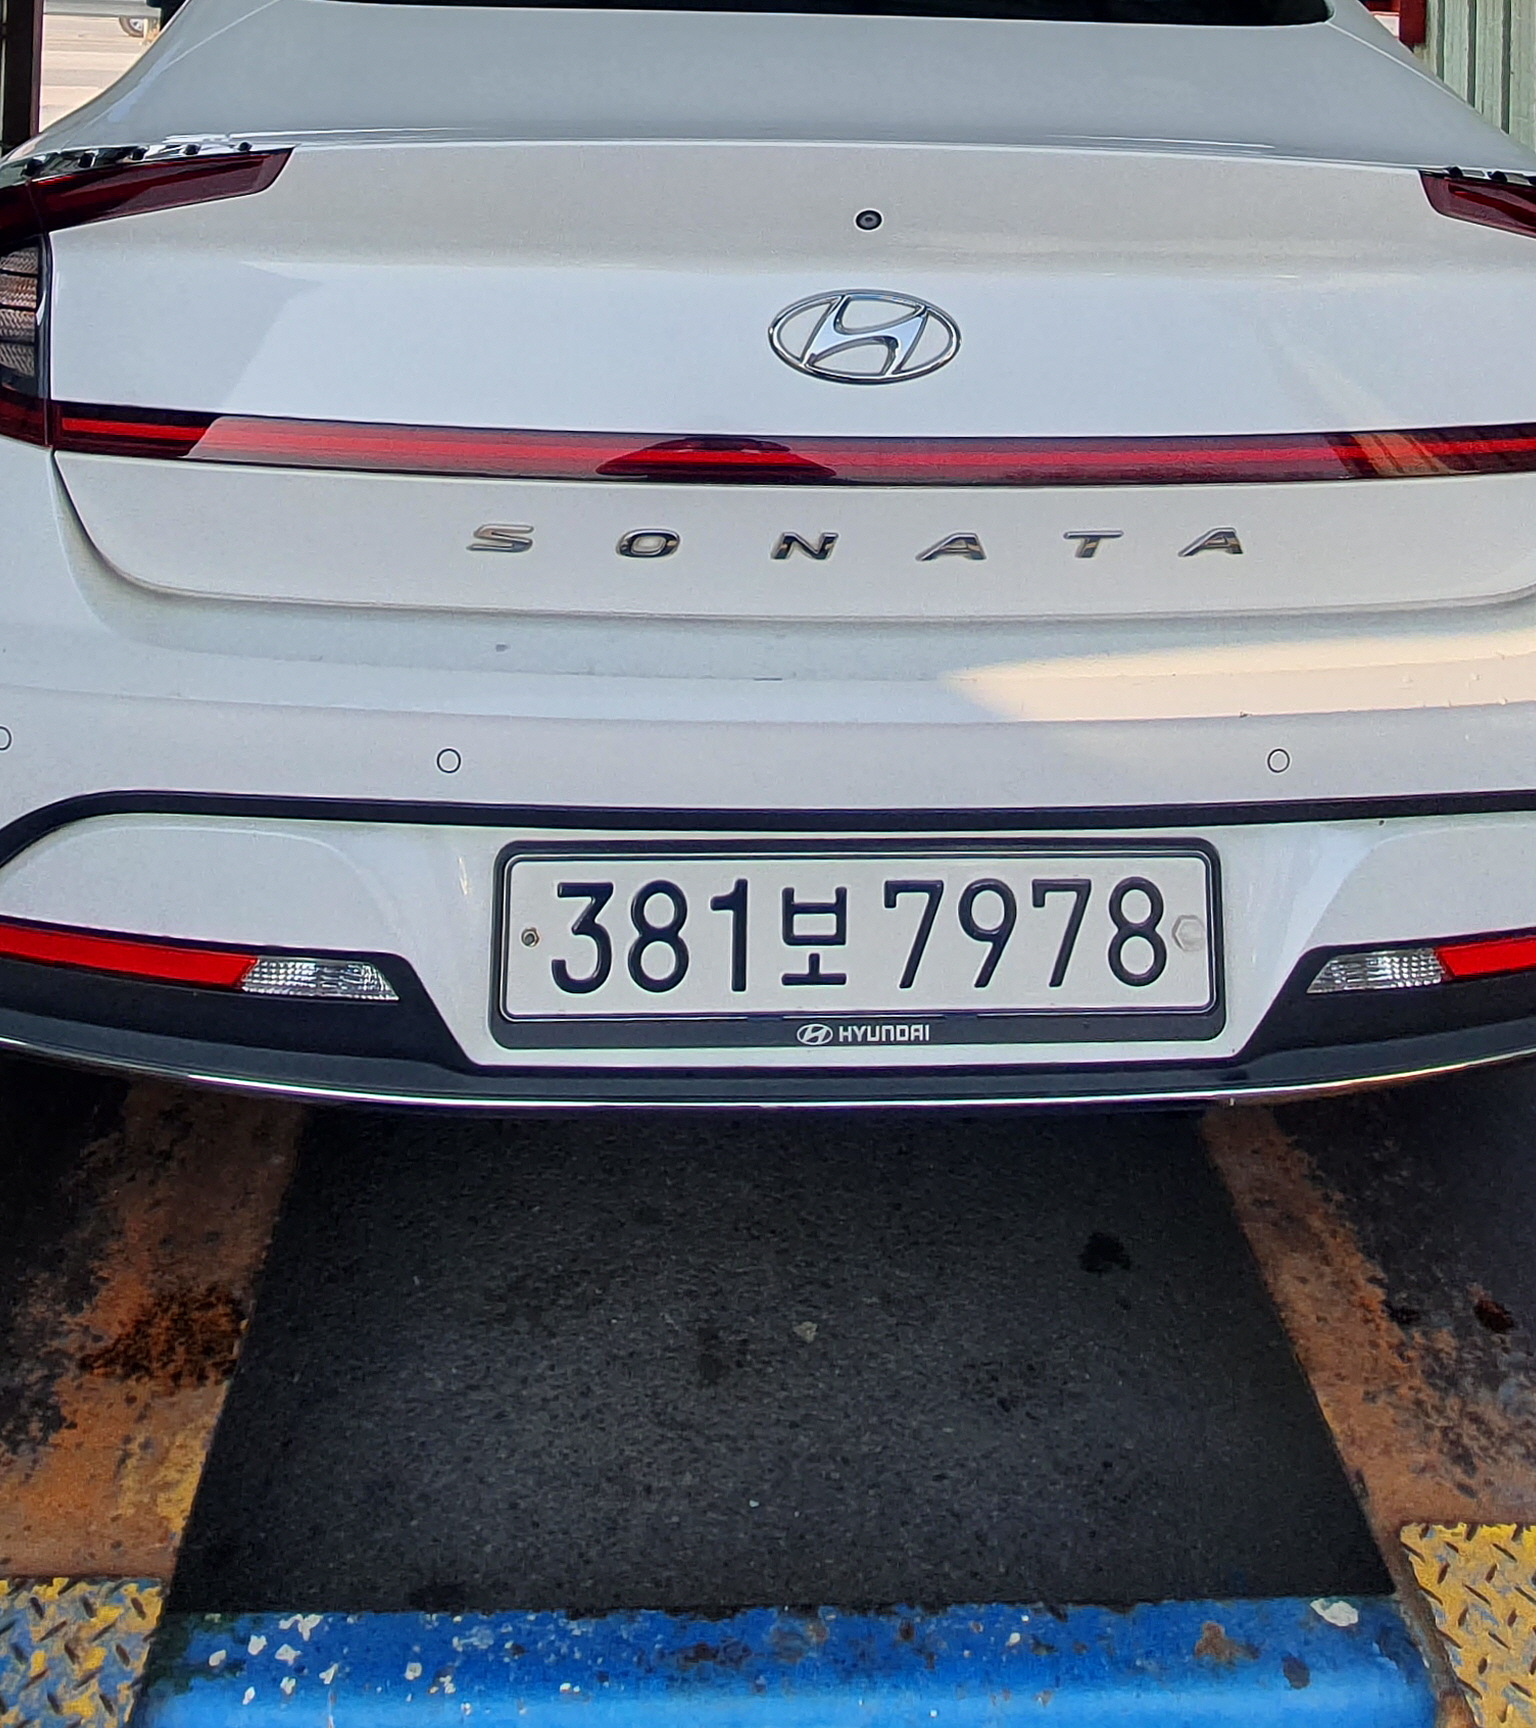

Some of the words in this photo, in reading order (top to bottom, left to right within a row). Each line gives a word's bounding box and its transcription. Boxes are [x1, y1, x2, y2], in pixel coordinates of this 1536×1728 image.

[466, 522, 1246, 563] SONATA
[550, 876, 1168, 994] 381보7978
[838, 1024, 931, 1044] HYUNDAI
